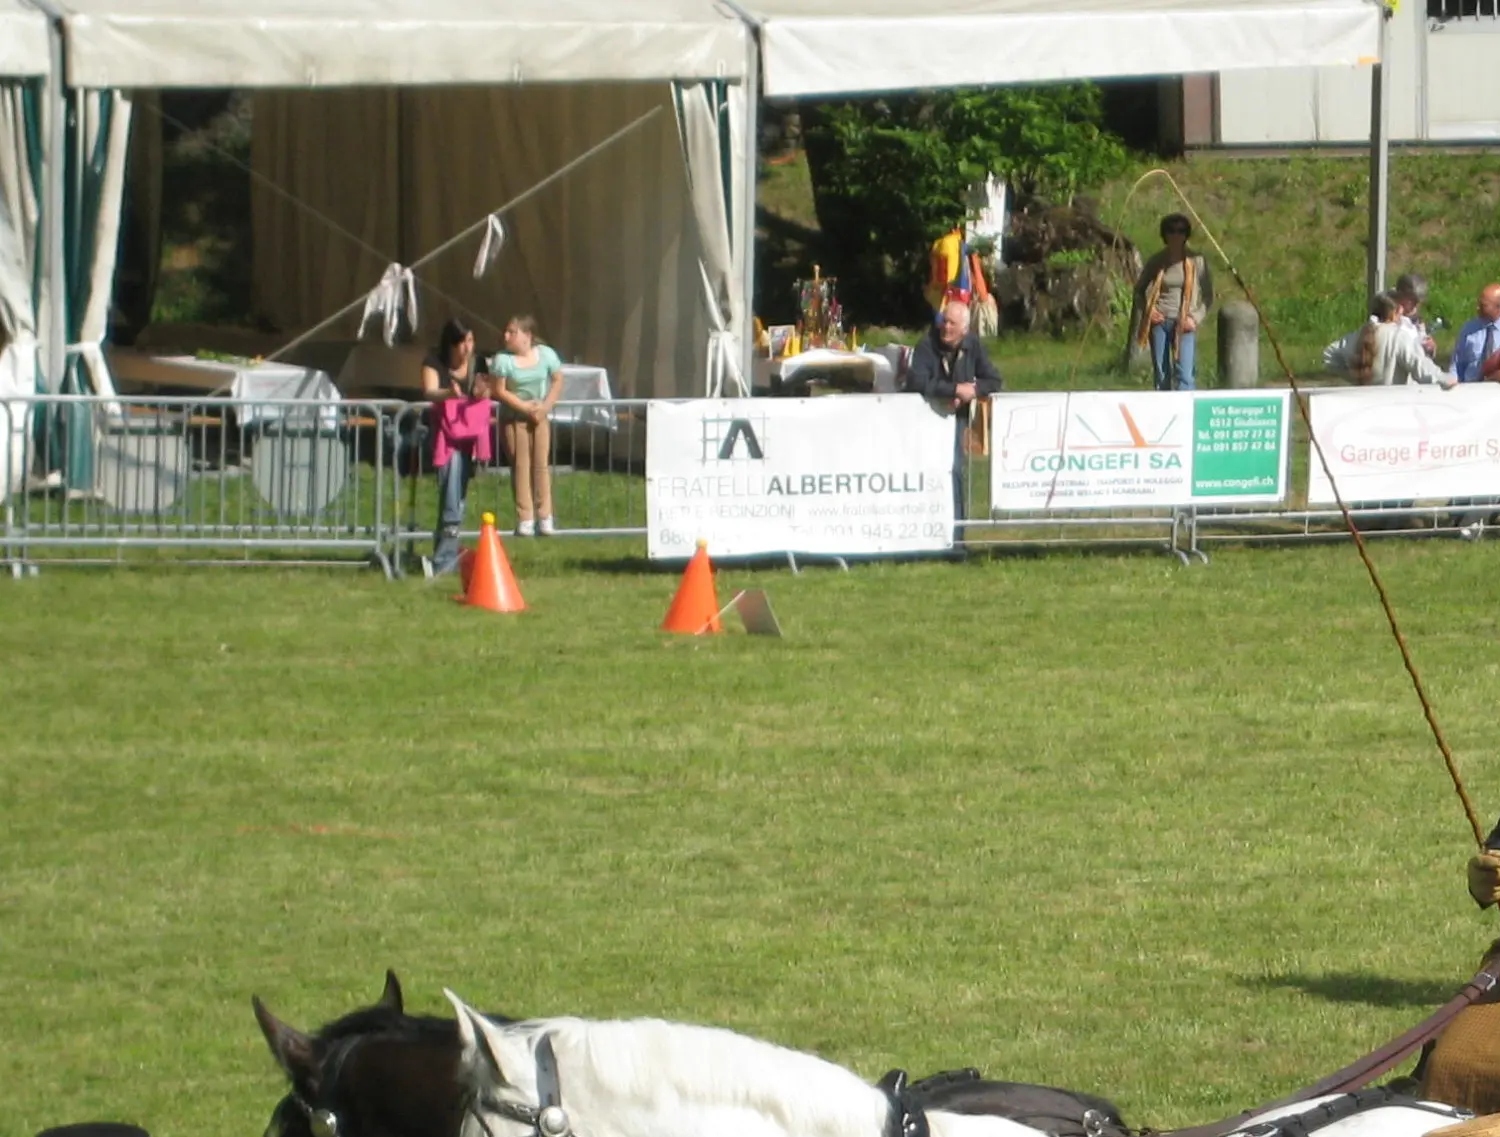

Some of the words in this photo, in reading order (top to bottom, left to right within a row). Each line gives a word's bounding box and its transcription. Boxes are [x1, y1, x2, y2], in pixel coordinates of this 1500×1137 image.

[1030, 453, 1139, 472] CONGEFI
[1149, 452, 1183, 470] SA
[1341, 444, 1411, 465] Garage
[1418, 441, 1479, 460] Ferrari
